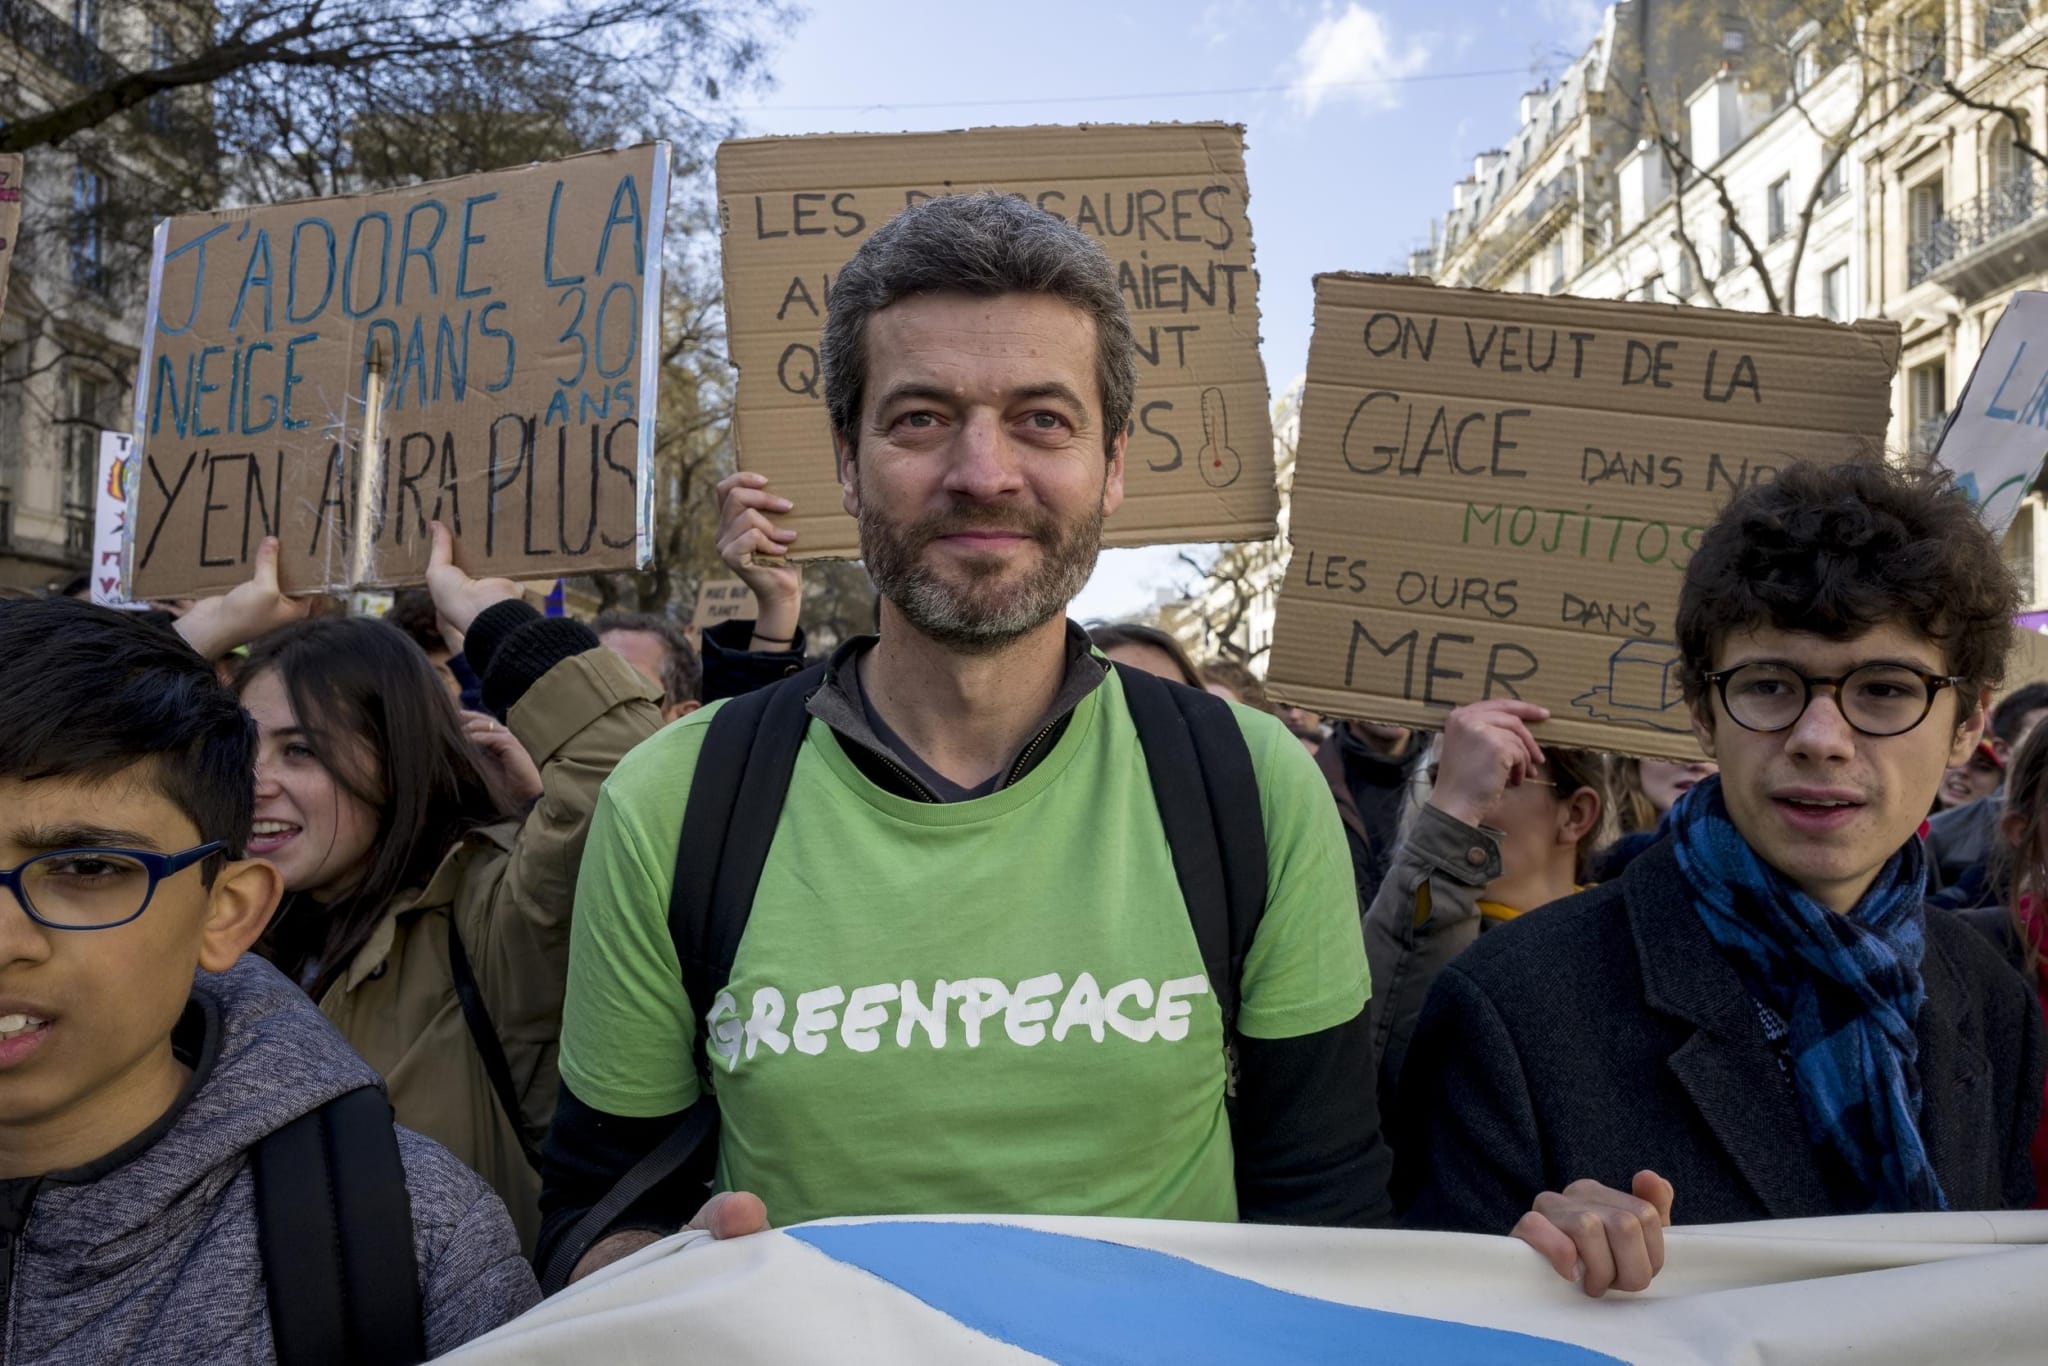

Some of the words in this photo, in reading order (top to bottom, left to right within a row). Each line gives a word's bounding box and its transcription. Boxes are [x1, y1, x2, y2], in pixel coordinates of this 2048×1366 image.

[157, 192, 499, 337] J'ADORE
[543, 174, 646, 288] LA
[754, 191, 867, 242] LES
[361, 302, 517, 411] DANS
[556, 281, 638, 388] 30
[1364, 310, 1438, 364] ON
[1463, 320, 1597, 380] VEUT
[1621, 338, 1680, 389] DE
[1702, 349, 1763, 405] LA
[544, 380, 636, 426] ANS
[1341, 389, 1533, 479] GLACE
[1581, 446, 1684, 490] DANS
[139, 446, 284, 570] Y'EN
[310, 430, 463, 557] AURA
[485, 412, 640, 558] PLUS
[1306, 550, 1368, 594] LES
[1396, 570, 1519, 619] OURS
[1561, 592, 1657, 637] DANS
[1345, 618, 1539, 709] MER
[705, 972, 1209, 1072] GREENPEACE
